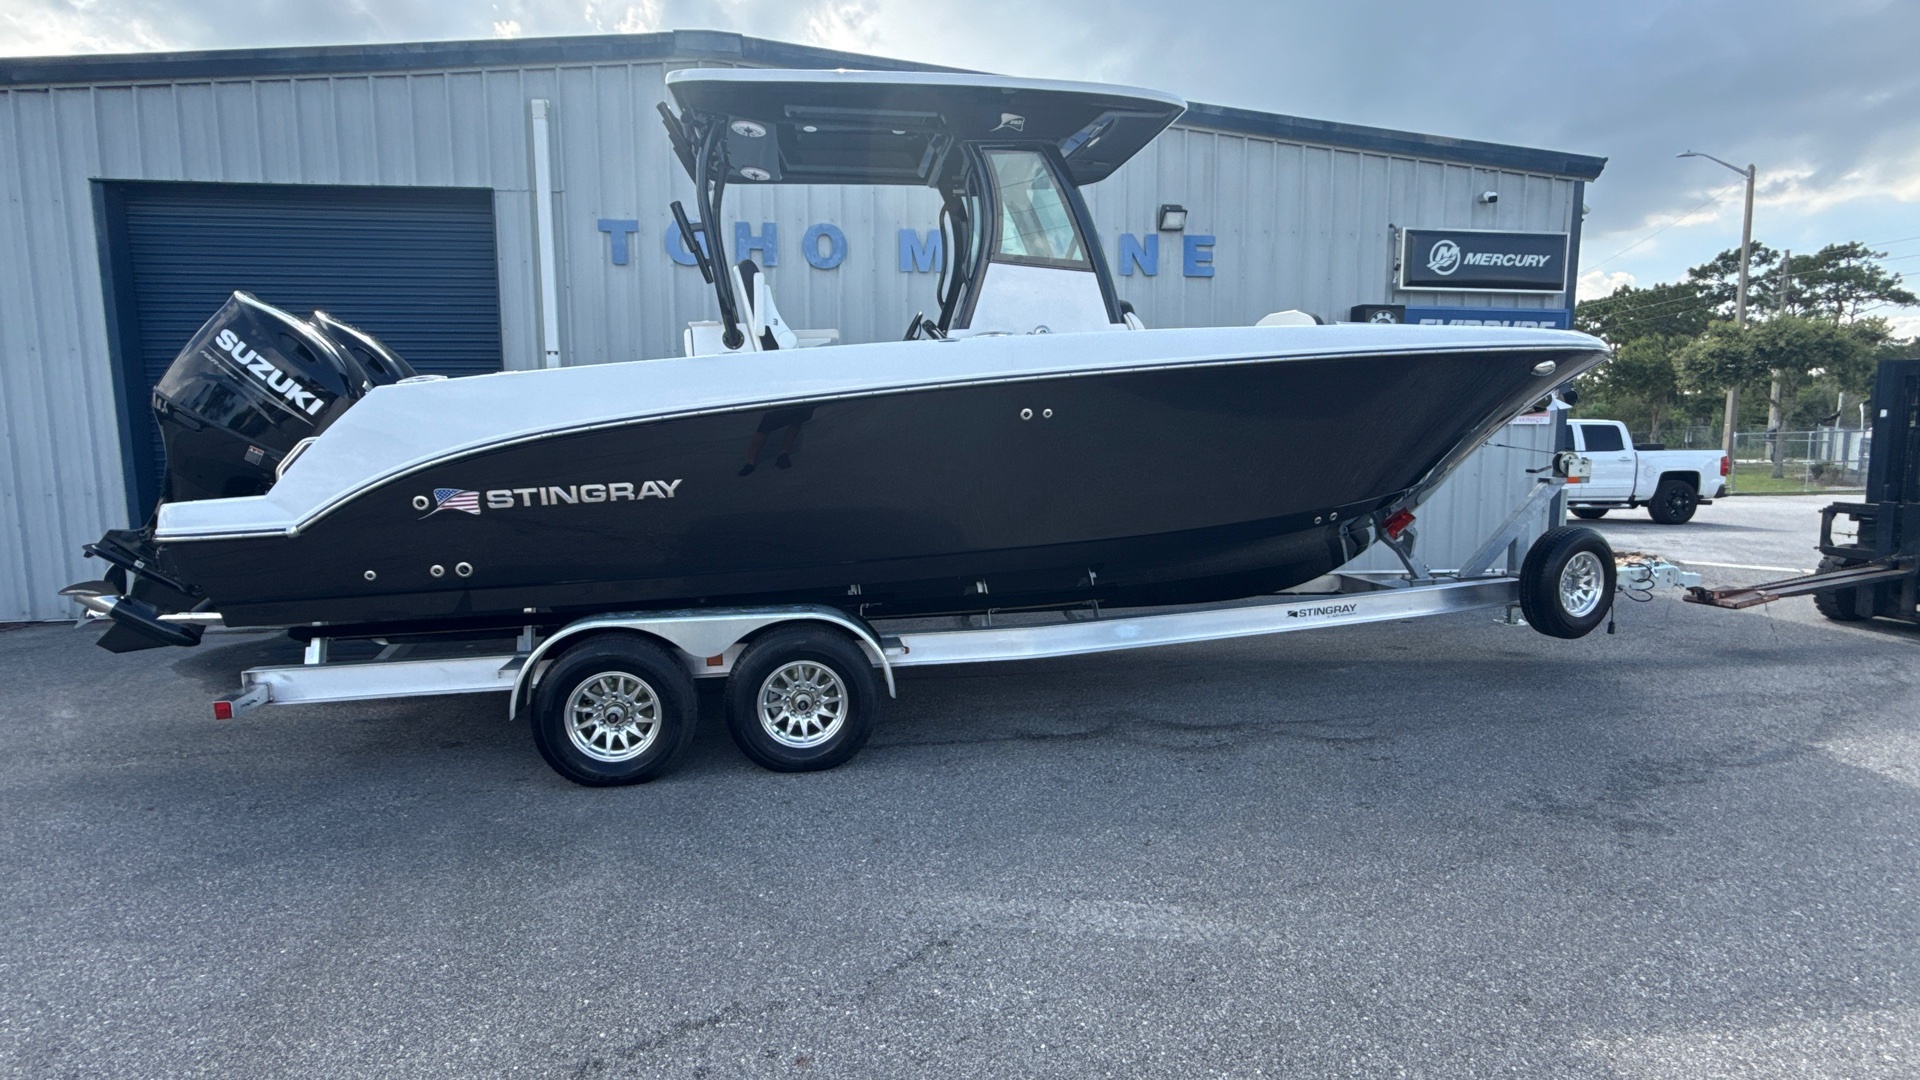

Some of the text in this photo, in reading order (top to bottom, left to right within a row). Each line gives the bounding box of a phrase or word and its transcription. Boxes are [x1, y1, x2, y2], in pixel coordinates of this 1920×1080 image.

[899, 228, 1216, 277] MNE
[1463, 252, 1551, 267] MERCURY
[215, 328, 325, 416] SUZUKI
[486, 478, 683, 509] STINGRAY
[1299, 603, 1357, 618] STINGRAY
